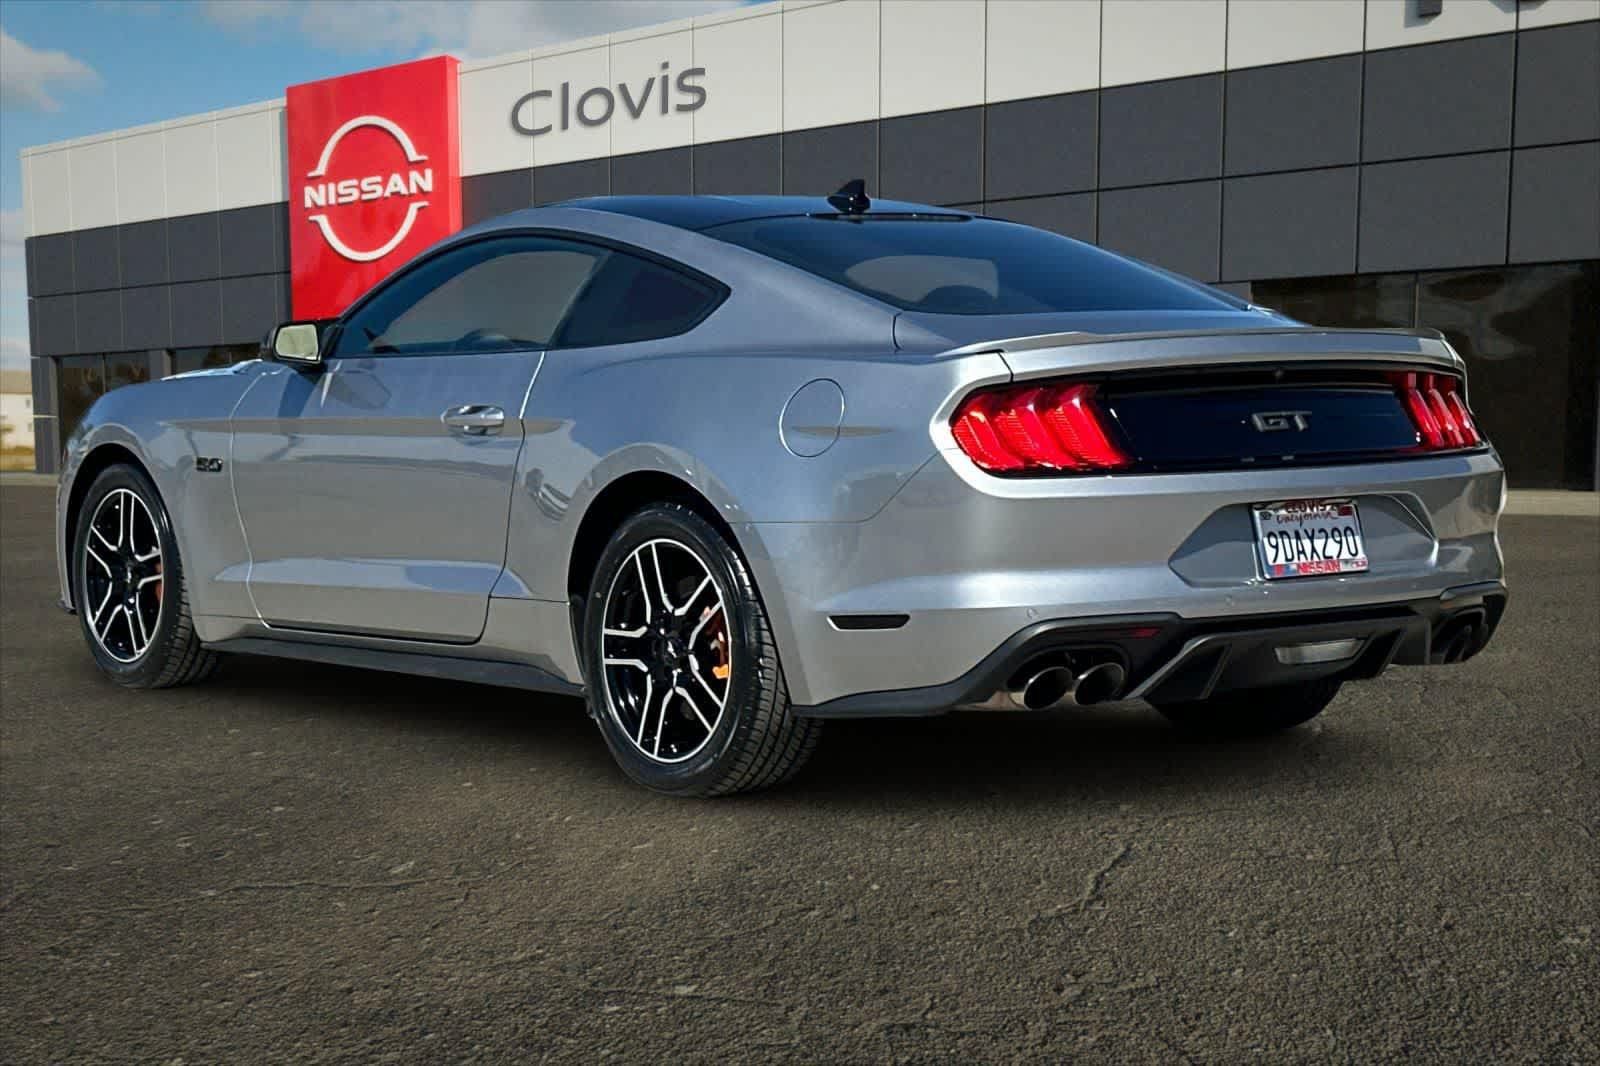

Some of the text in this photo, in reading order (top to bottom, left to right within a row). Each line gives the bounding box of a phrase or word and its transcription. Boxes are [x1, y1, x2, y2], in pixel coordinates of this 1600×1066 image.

[510, 61, 707, 136] Clovis
[304, 168, 433, 208] NISSAN
[1251, 410, 1312, 432] GT
[1266, 526, 1359, 563] 9DAX290
[1296, 559, 1341, 576] NISSAN
